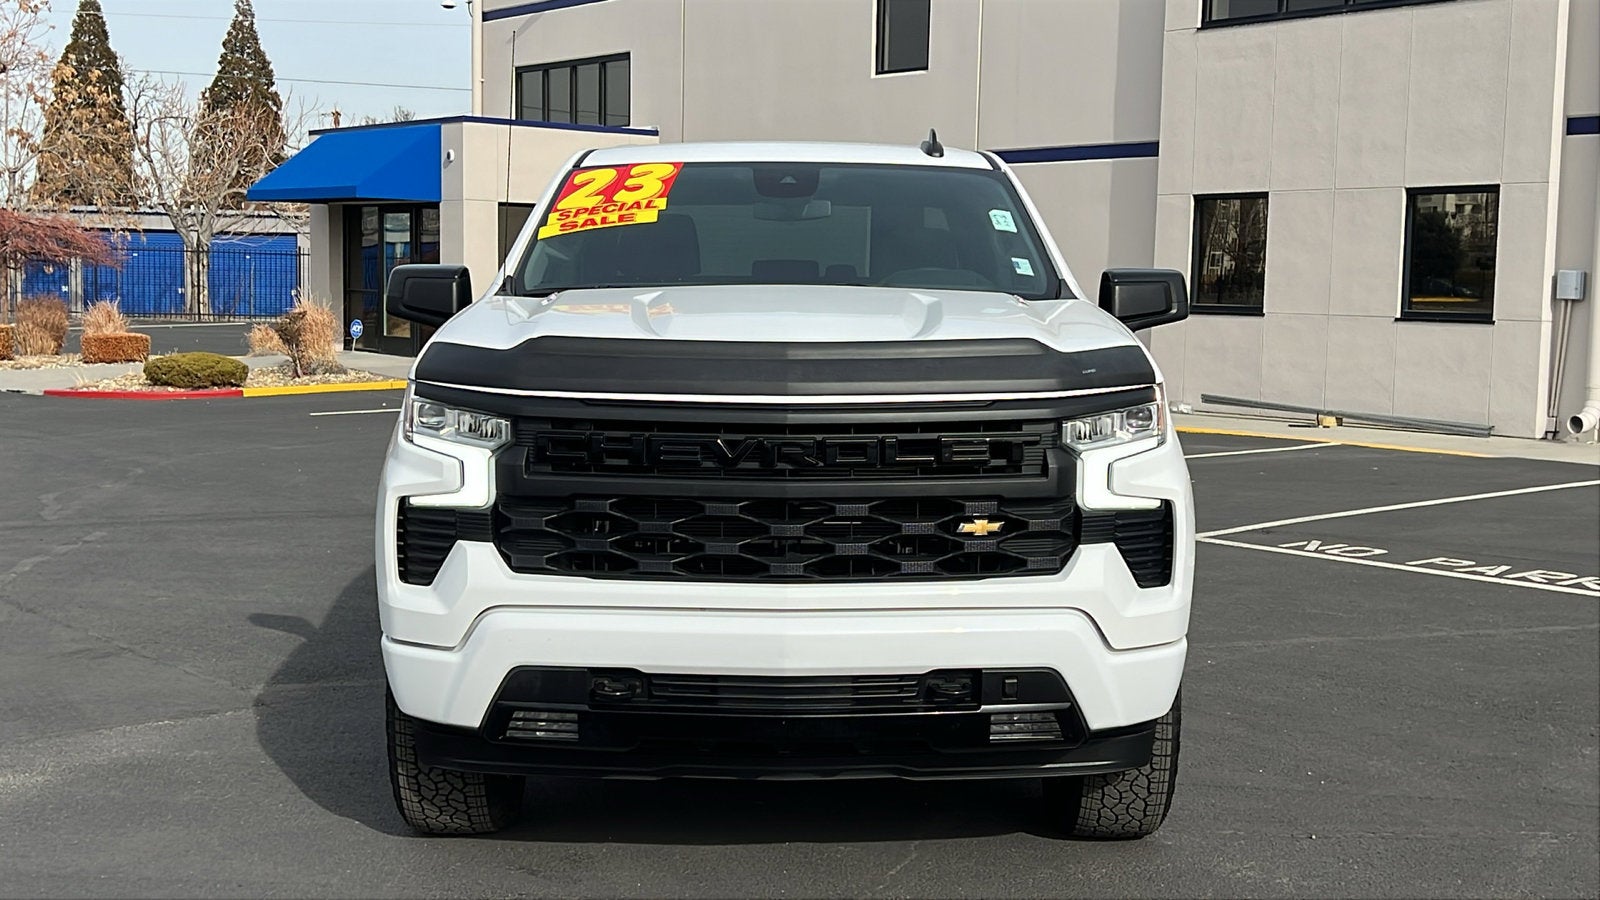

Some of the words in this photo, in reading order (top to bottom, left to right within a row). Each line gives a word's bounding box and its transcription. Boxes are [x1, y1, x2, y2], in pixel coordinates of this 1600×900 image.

[557, 163, 677, 210] 23
[556, 199, 660, 221] SPECIAL
[558, 213, 635, 231] SALE
[536, 431, 1042, 468] CHEVROLET
[1278, 540, 1389, 557] NO
